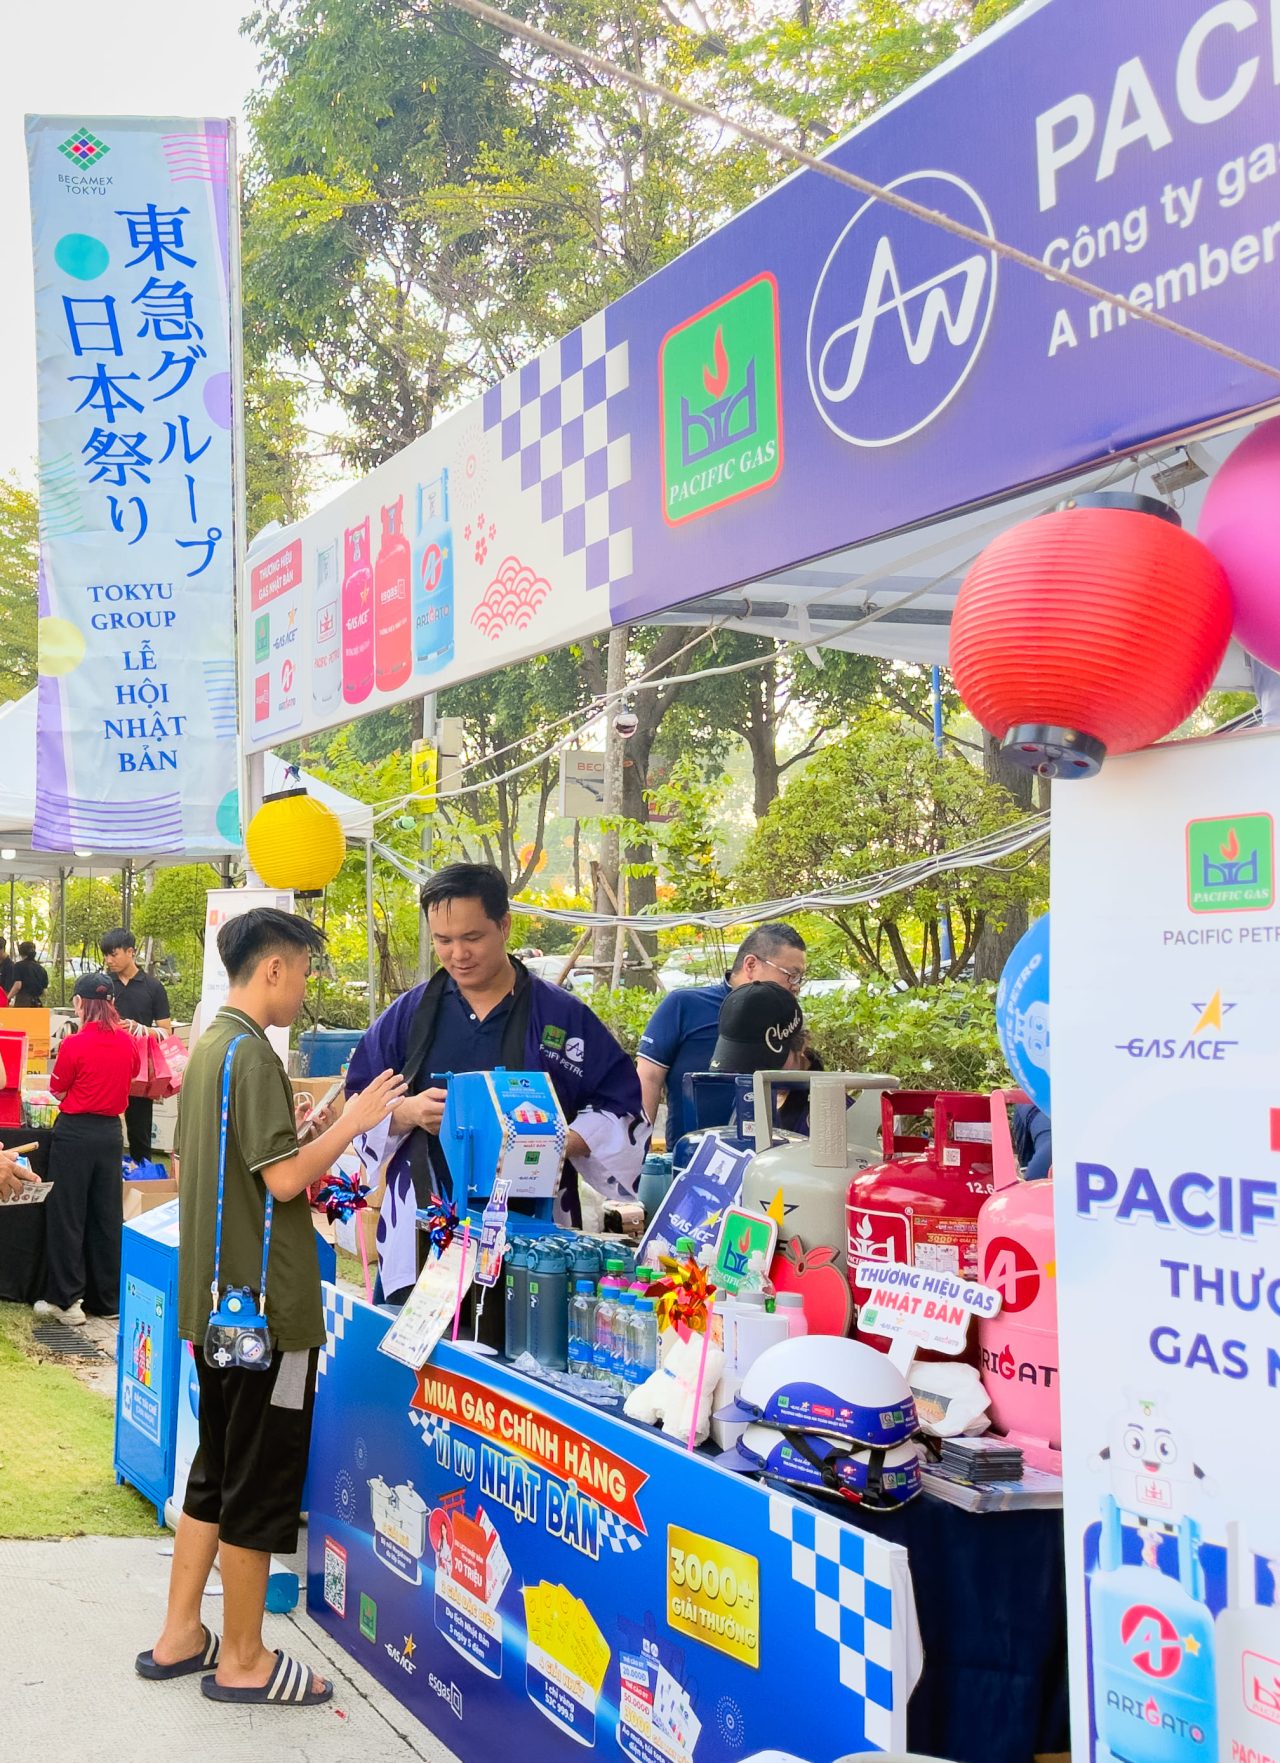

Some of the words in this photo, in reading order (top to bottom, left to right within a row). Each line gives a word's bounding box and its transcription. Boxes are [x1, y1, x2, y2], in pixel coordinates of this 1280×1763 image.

[58, 174, 113, 186] BECAMEX
[66, 185, 107, 196] TOKYU
[1042, 205, 1148, 281] Công
[1160, 177, 1203, 228] ty
[1047, 308, 1078, 358] A
[114, 203, 223, 578] 東急グループ
[61, 295, 154, 546] 日本祭り
[669, 458, 735, 505] PACIFIC
[740, 440, 776, 473] GAS
[87, 583, 174, 601] TOKYU
[91, 610, 176, 631] GROUP
[416, 604, 450, 631] ARIGATO
[123, 640, 157, 671] LỄ
[115, 678, 169, 710] HỘI
[103, 711, 187, 743] NHẬT
[118, 745, 178, 773] BẢN
[577, 762, 604, 771] BEC
[1193, 889, 1243, 903] PACIFIC
[1245, 887, 1269, 901] GAS
[1164, 928, 1233, 946] PACIFIC
[1115, 1038, 1175, 1059] GAS
[1180, 1039, 1238, 1061] ACE
[1076, 1161, 1278, 1236] PACIF
[669, 1212, 692, 1233] GAS
[688, 1227, 715, 1243] ACE
[861, 1267, 920, 1289] THƯƠNG
[922, 1276, 960, 1299] HIỆU
[963, 1288, 994, 1311] GAS
[873, 1289, 922, 1316] NHẬT
[923, 1299, 965, 1326] BẢN
[1149, 1325, 1249, 1380] GAS
[424, 1379, 457, 1414] MUA
[461, 1392, 495, 1431] GAS
[499, 1409, 558, 1464] CHÍNH
[564, 1441, 627, 1502] HÃNG
[434, 1427, 451, 1470] VI
[454, 1439, 475, 1482] VU
[480, 1444, 540, 1523] NHẬT
[546, 1478, 600, 1561] BẢN
[454, 1557, 463, 1573] 70
[464, 1563, 483, 1588] TRIỆU
[671, 1547, 754, 1609] 3000+
[672, 1597, 697, 1624] GIẢI
[699, 1609, 756, 1648] THƯỞNG
[385, 1643, 400, 1663] GAS
[399, 1656, 417, 1675] ACE
[428, 1672, 451, 1703] esgas
[1106, 1690, 1205, 1744] ARIGATO
